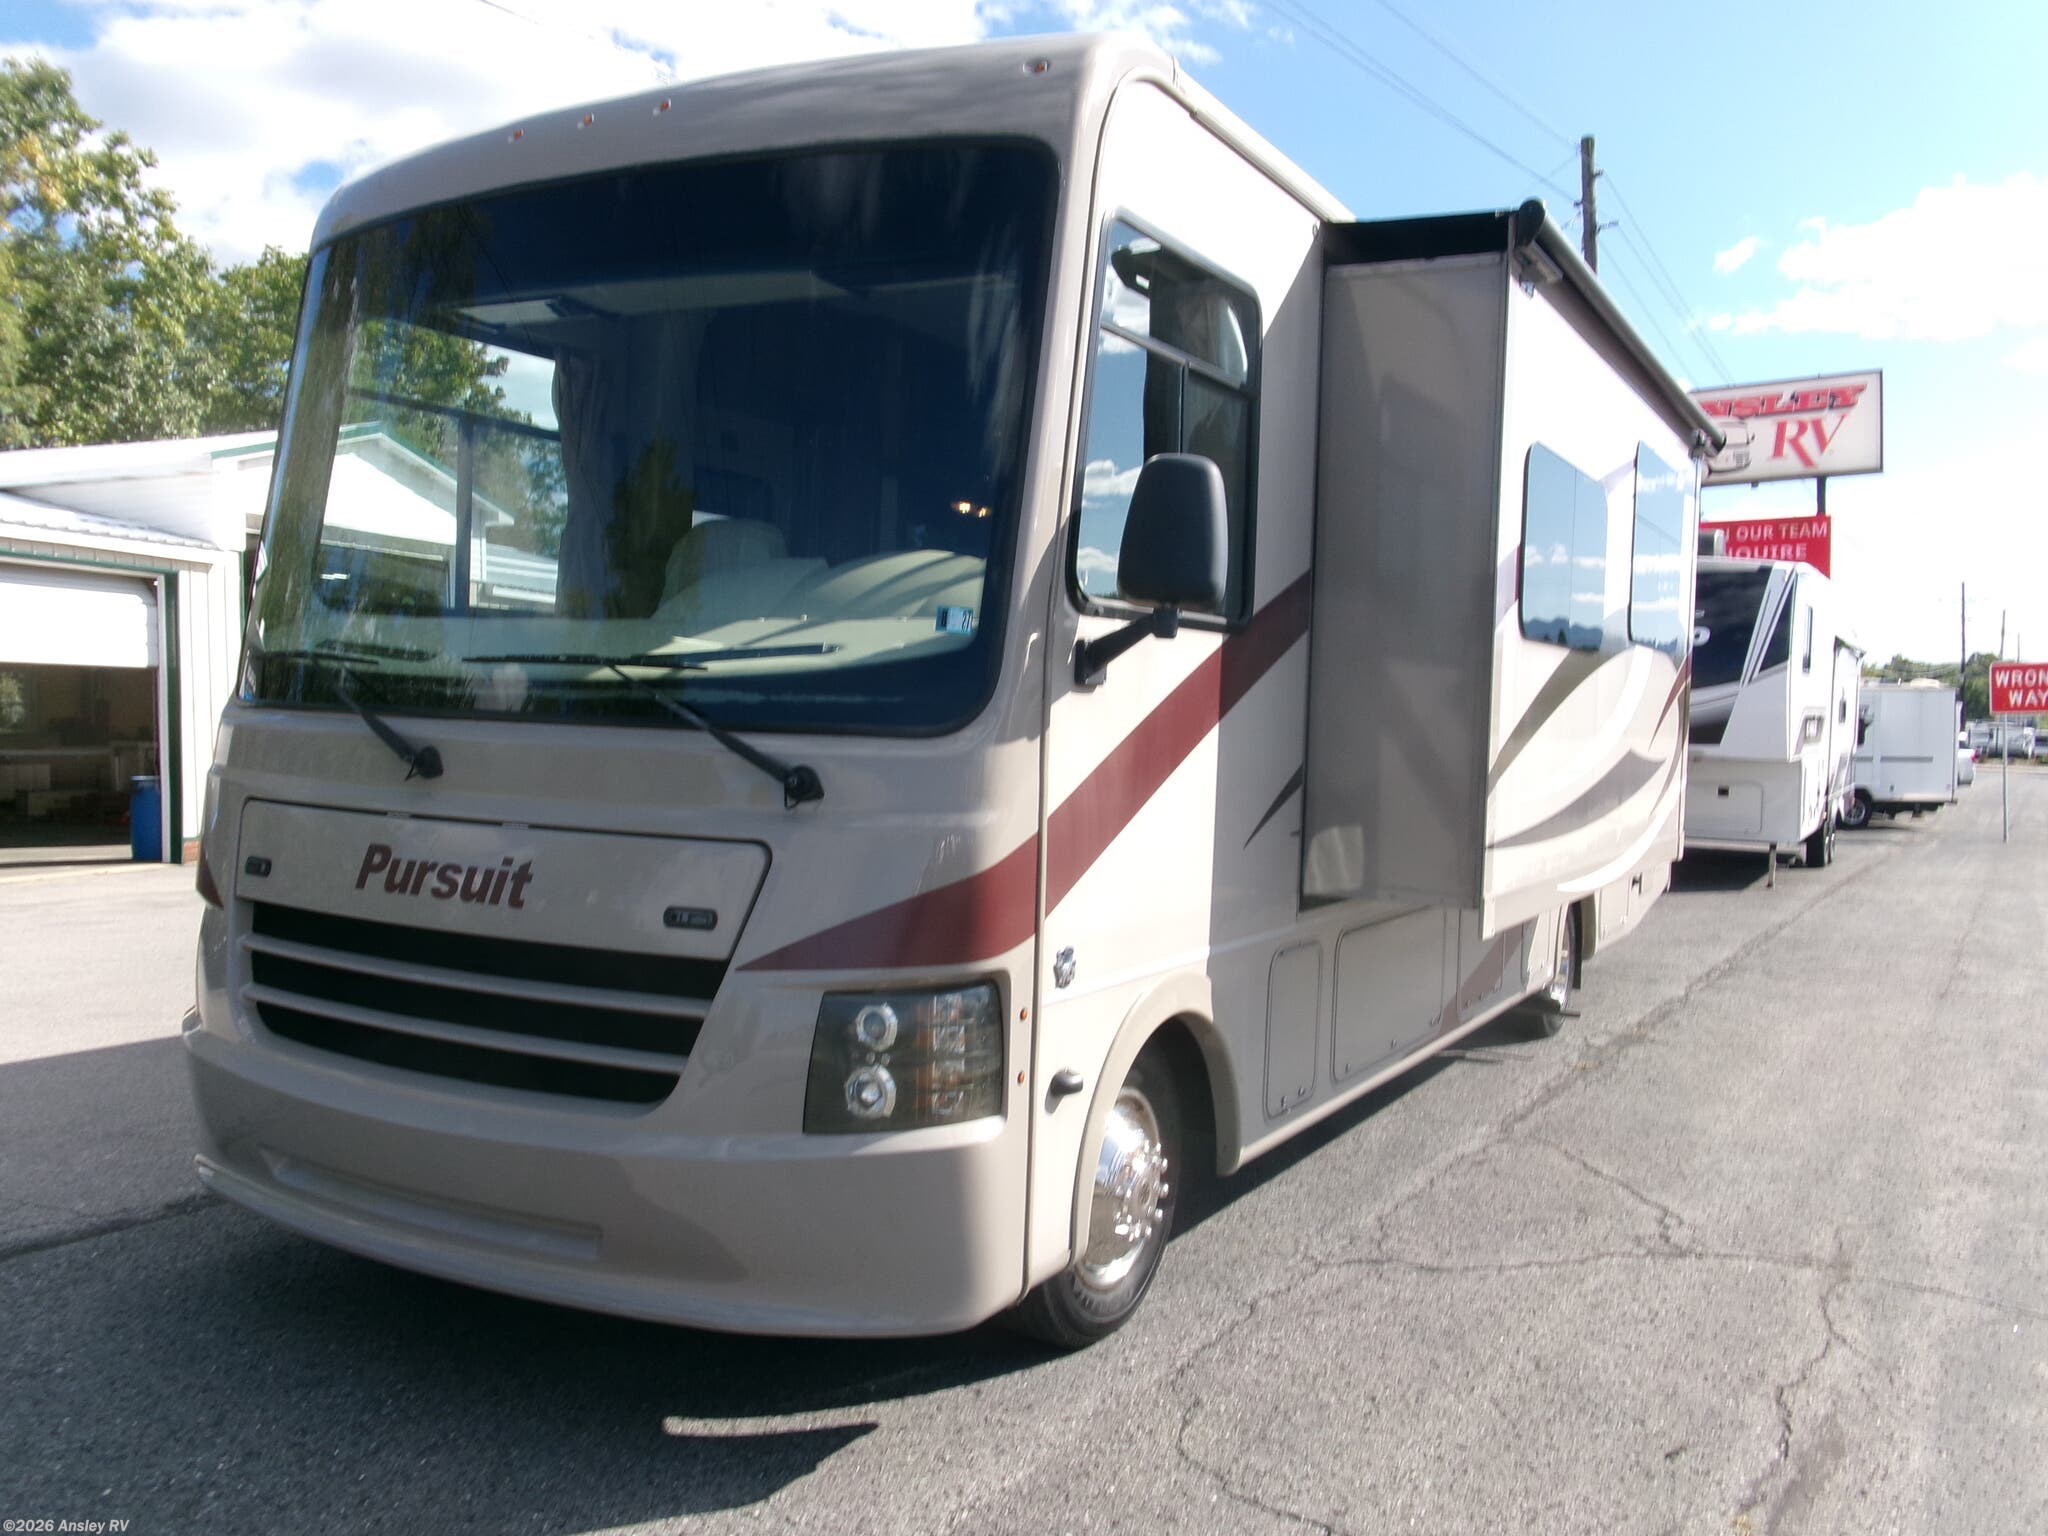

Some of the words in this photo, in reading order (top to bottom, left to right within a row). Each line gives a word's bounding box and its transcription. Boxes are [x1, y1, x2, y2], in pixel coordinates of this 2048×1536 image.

[1699, 384, 1867, 419] NSLEY
[1771, 413, 1850, 469] RV
[1736, 525, 1774, 541] OUR
[1780, 521, 1828, 539] TEAM
[1728, 543, 1807, 560] QUIRE
[1995, 668, 2048, 688] WRON
[2008, 688, 2048, 708] WAY
[355, 843, 534, 909] Pursuit
